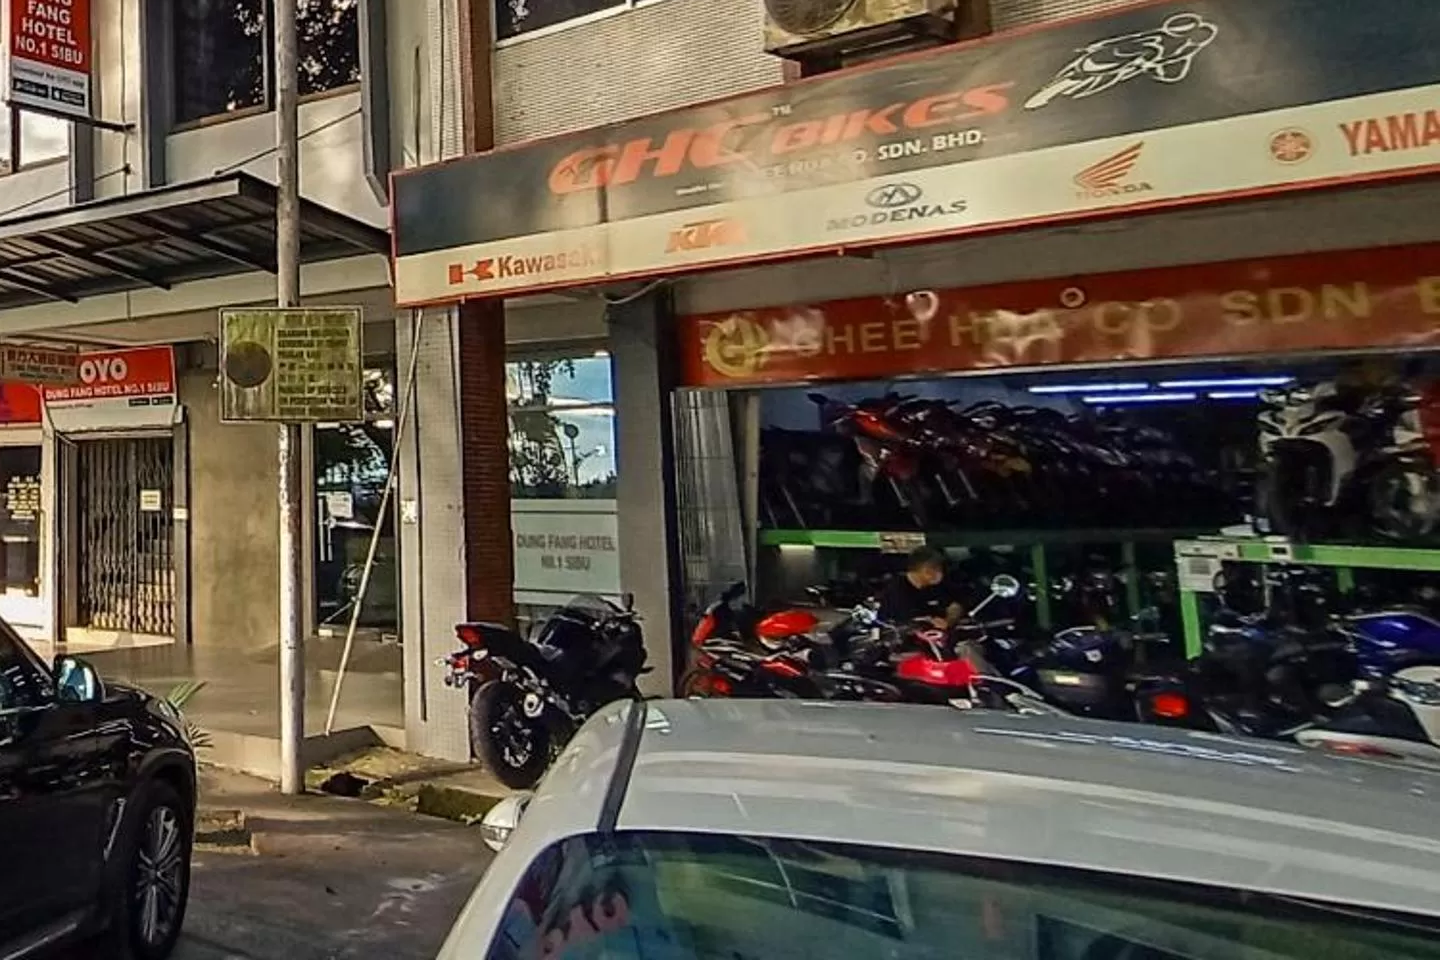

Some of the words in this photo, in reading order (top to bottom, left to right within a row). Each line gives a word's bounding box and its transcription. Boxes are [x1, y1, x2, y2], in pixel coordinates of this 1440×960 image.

[27, 0, 71, 25] FANG
[21, 16, 78, 46] HOTEL
[15, 34, 48, 57] NO.1
[50, 43, 84, 65] SIBU
[878, 140, 928, 162] SDN.
[931, 130, 987, 152] BHD.
[825, 200, 967, 231] MODENAS
[1220, 281, 1371, 325] SDN
[80, 357, 127, 384] OYO
[94, 384, 124, 397] HOTEL
